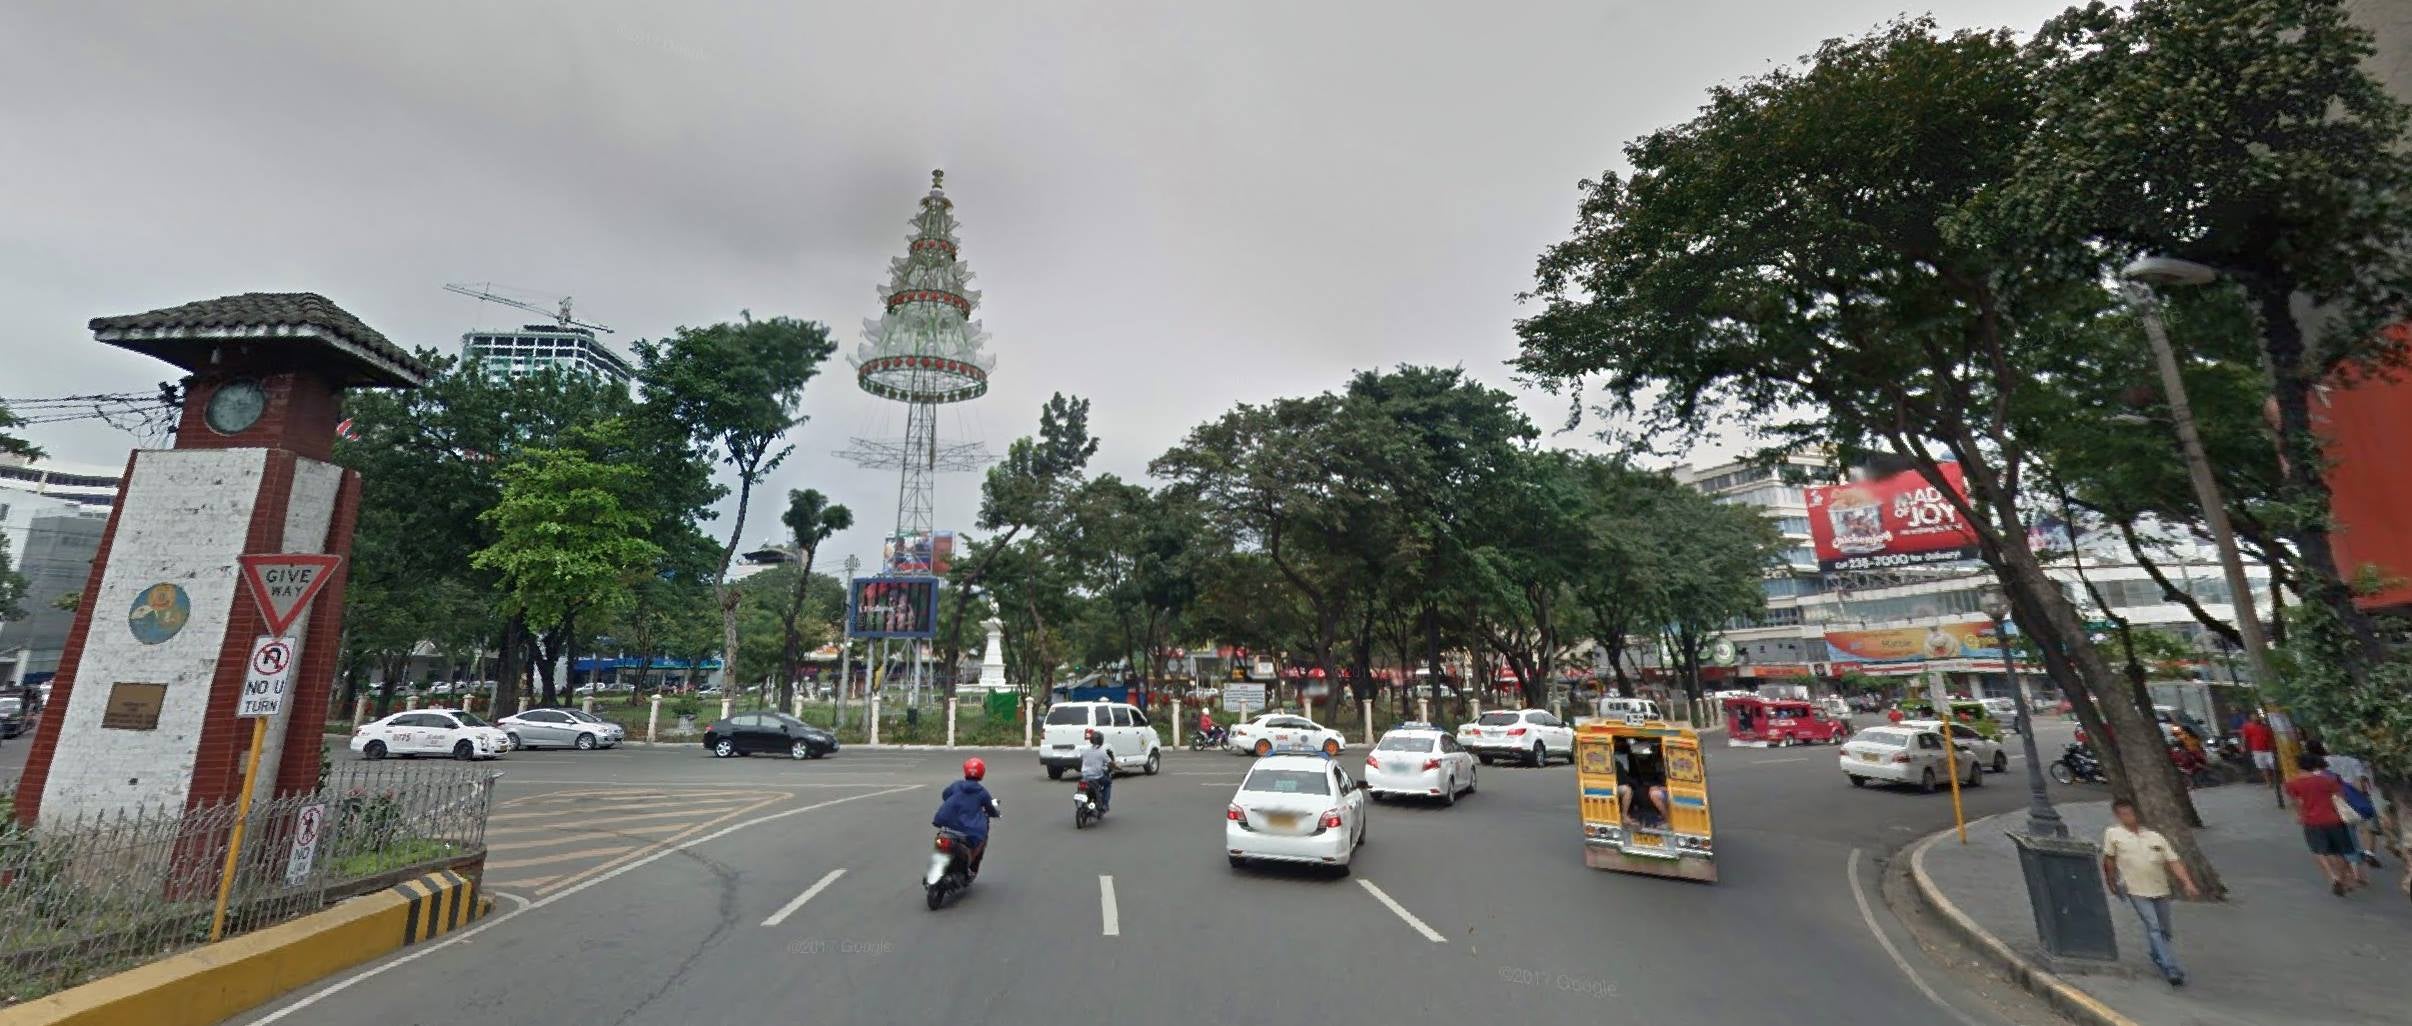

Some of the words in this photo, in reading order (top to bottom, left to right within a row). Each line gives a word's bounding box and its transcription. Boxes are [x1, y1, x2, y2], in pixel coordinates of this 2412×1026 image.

[1908, 502, 1957, 528] JOY
[265, 569, 312, 583] GIVE
[271, 585, 303, 597] WAY
[246, 680, 269, 695] NO
[274, 680, 285, 695] U
[245, 700, 279, 713] TURN
[294, 846, 311, 860] NO
